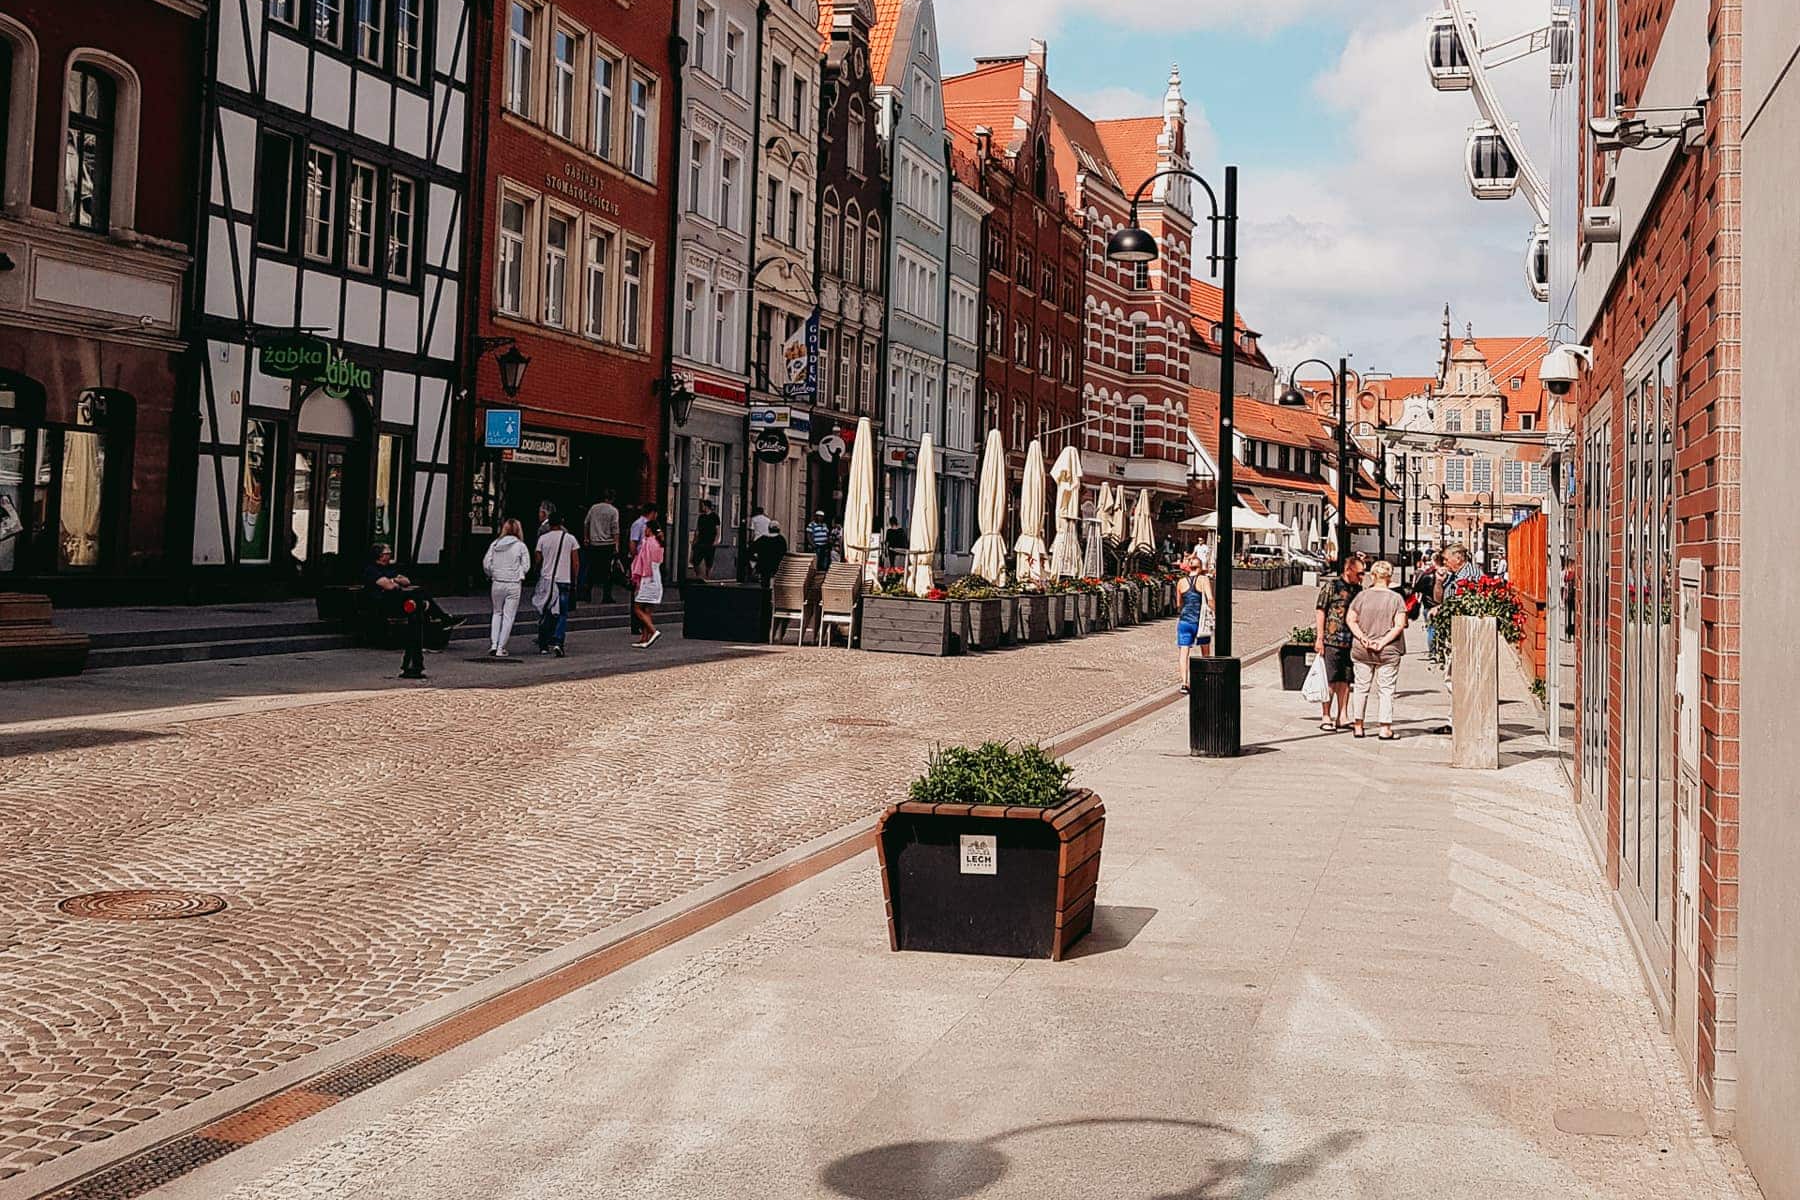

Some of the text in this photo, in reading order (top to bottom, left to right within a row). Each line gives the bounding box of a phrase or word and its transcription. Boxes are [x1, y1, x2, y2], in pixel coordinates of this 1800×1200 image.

[546, 174, 619, 216] STOMATOLOGICZNE
[264, 347, 322, 363] żabka
[808, 324, 818, 382] GOLDEN
[966, 855, 992, 863] LECH
